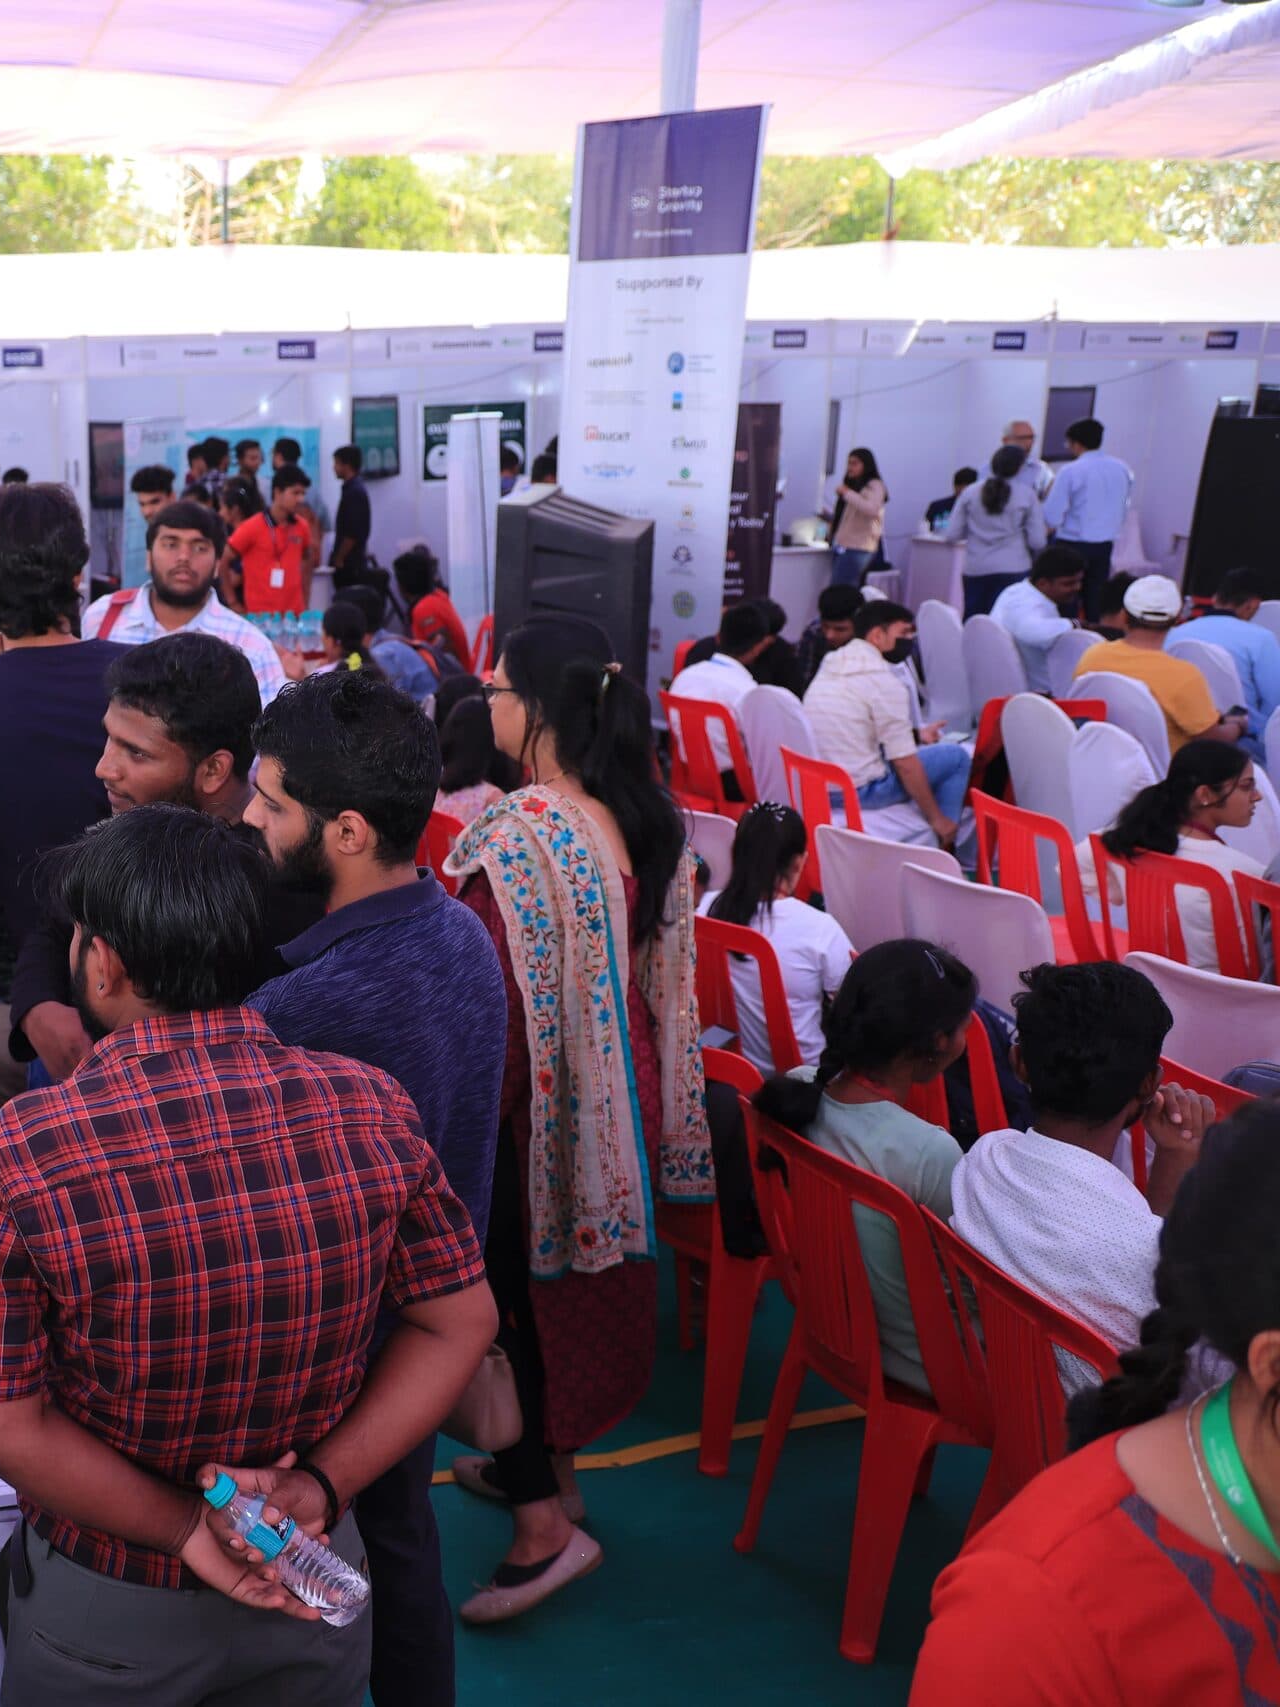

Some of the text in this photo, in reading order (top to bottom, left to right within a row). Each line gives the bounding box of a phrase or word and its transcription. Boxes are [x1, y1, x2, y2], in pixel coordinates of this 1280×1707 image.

[657, 185, 703, 198] Startup
[657, 198, 703, 213] Gravity
[616, 273, 704, 293] Supported By
